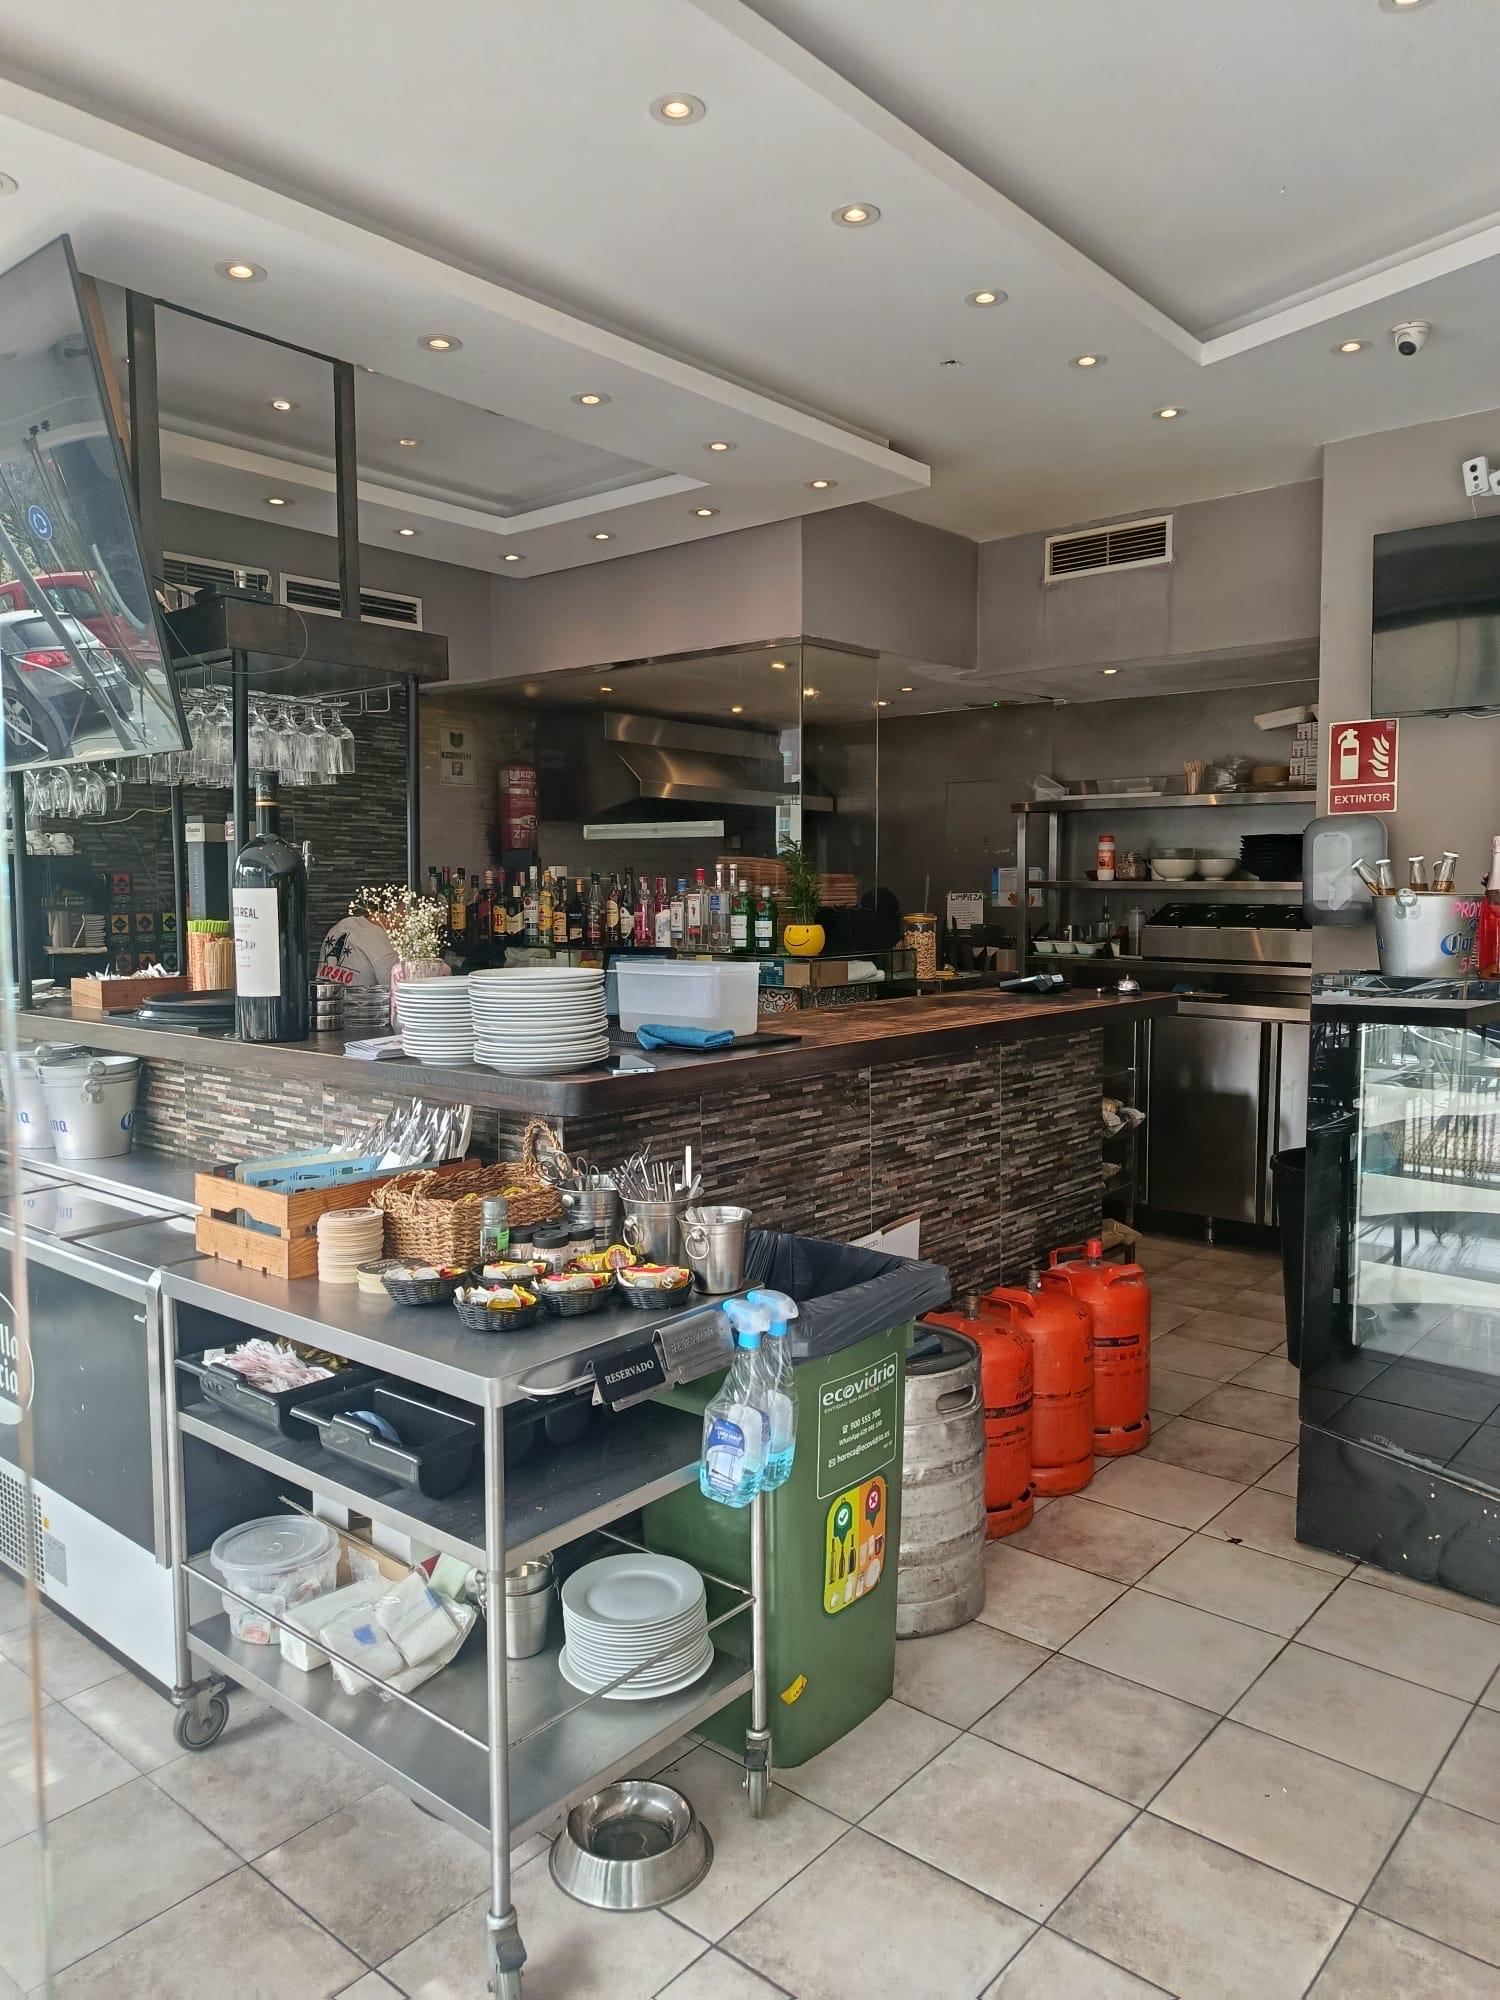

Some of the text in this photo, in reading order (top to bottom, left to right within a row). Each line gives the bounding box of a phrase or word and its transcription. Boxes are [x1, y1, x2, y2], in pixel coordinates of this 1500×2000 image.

[1334, 793, 1391, 804] EXTINTOR
[1453, 901, 1482, 918] PROM
[604, 1359, 654, 1385] RESERVADO
[822, 1363, 896, 1406] ecovidrio
